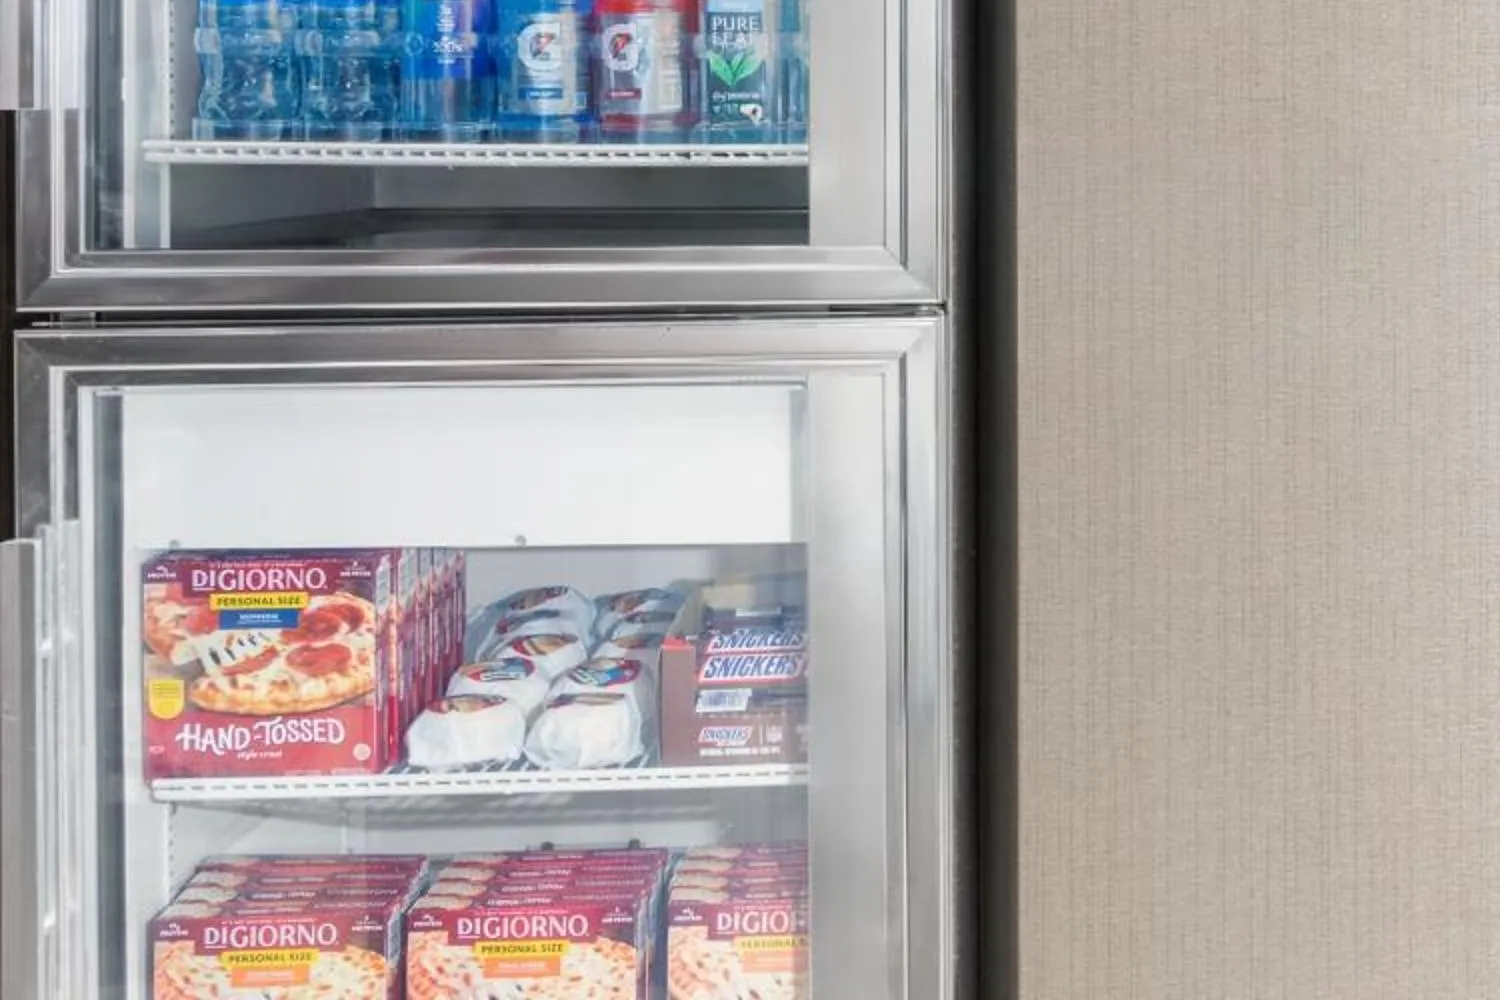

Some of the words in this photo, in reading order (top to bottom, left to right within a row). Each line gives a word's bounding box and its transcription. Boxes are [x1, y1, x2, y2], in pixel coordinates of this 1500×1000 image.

[711, 15, 760, 31] PURE
[191, 567, 328, 592] DIGIORNO
[216, 596, 277, 606] PERSONAL
[704, 654, 801, 679] SNICKERS
[203, 923, 339, 949] DIGIORNO
[456, 914, 590, 939] DIGIORNO
